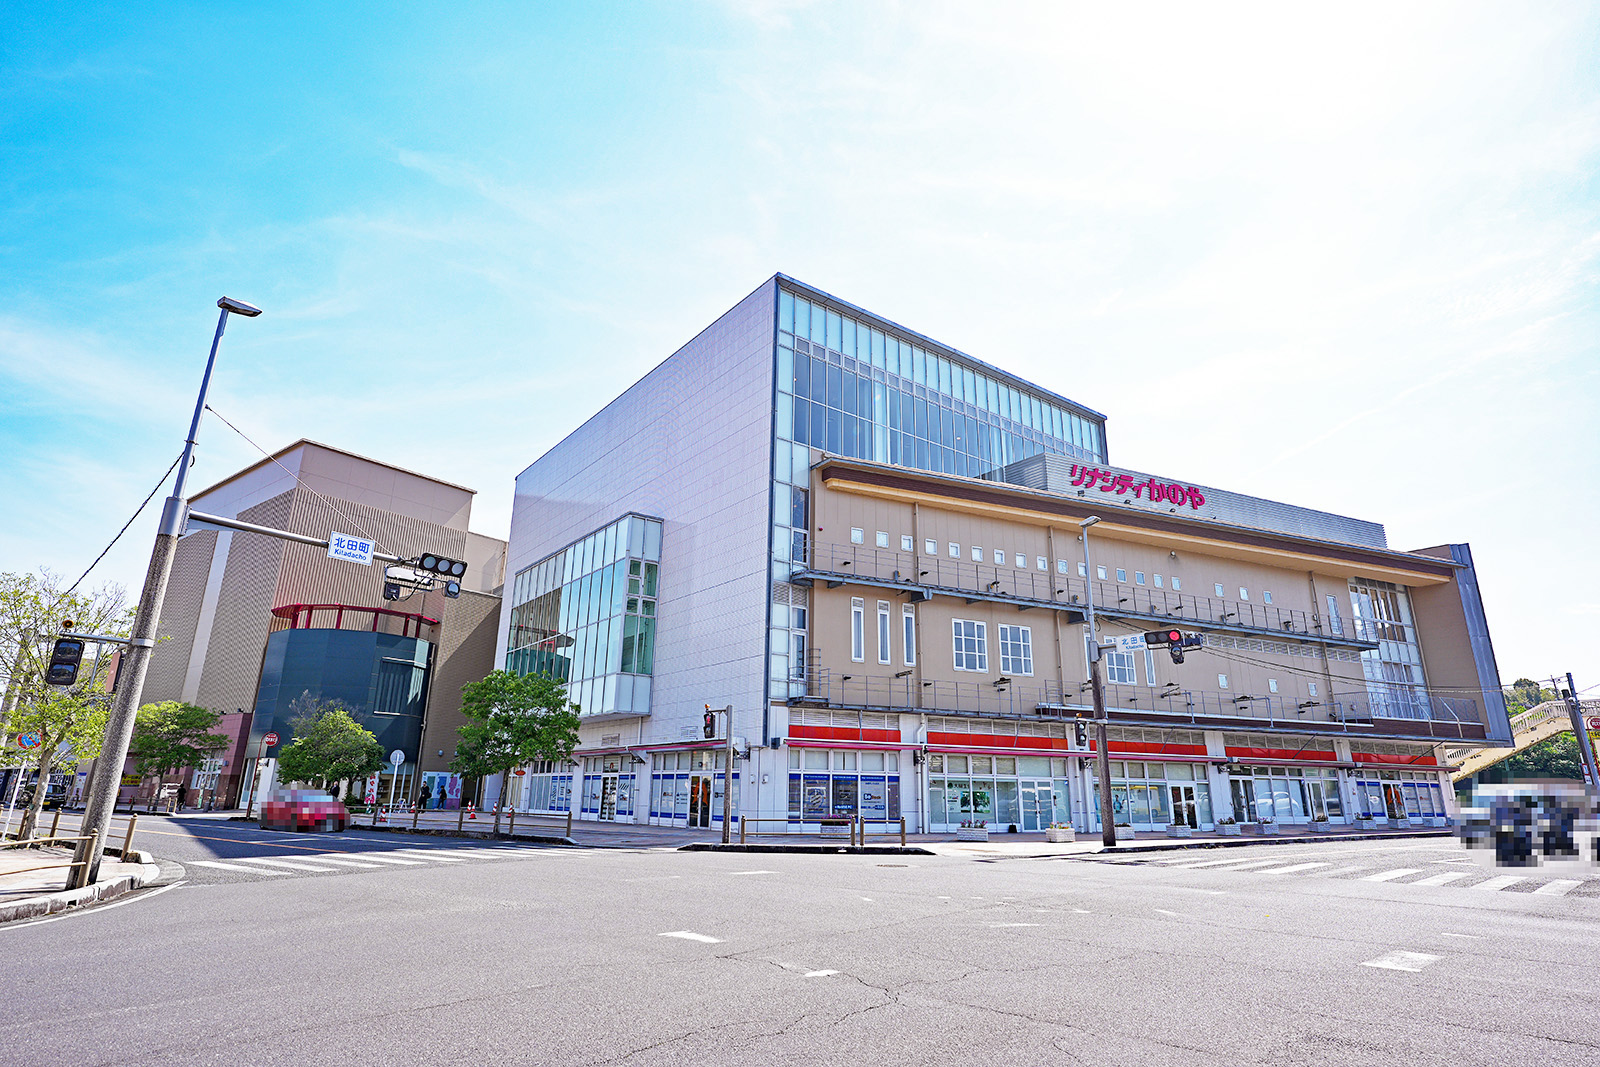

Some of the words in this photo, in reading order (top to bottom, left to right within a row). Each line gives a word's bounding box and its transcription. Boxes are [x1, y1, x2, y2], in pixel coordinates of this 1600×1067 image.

[1071, 464, 1205, 510] リナシティかのや
[334, 537, 370, 554] 北田町
[334, 548, 367, 560] Kitadacho
